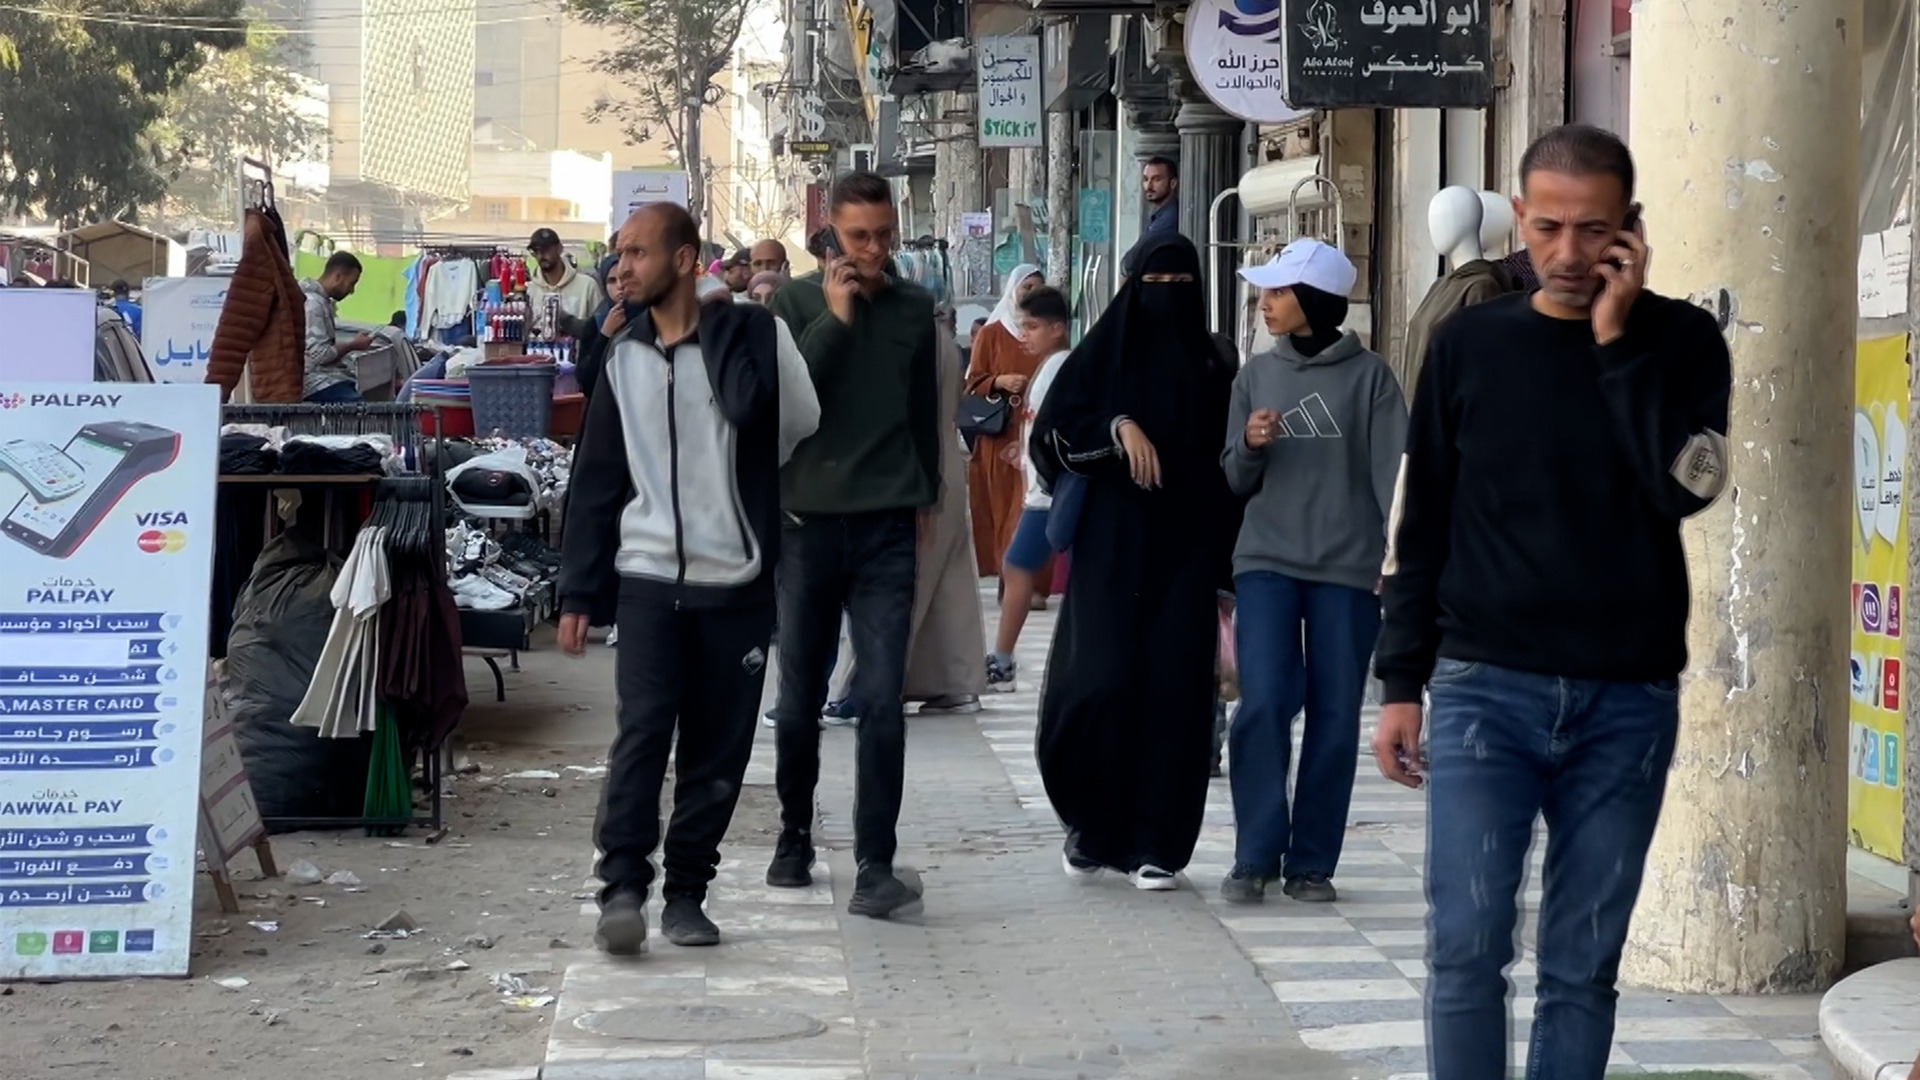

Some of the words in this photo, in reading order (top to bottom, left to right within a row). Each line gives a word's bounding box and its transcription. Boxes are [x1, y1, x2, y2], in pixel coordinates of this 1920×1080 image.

[1218, 48, 1246, 69] الله
[1249, 54, 1279, 72] حرز
[1215, 75, 1281, 90] والحوالات
[31, 394, 122, 407] PALPAY
[136, 510, 188, 526] VISA
[43, 576, 95, 587] خدمات
[27, 588, 115, 603] PALPAY
[58, 615, 101, 632] أكواد
[107, 620, 149, 631] سحب
[94, 697, 144, 710] CARD
[67, 727, 142, 743] رسوم
[39, 748, 140, 766] أرصدة
[32, 788, 78, 800] خدمات
[0, 801, 78, 815] AWWAL
[85, 799, 123, 814] PAY
[28, 830, 69, 849] شحن
[74, 834, 84, 847] و
[89, 832, 136, 846] سحب
[66, 858, 133, 875] دفع
[9, 885, 72, 903] أرصدة
[78, 884, 132, 902] شحن
